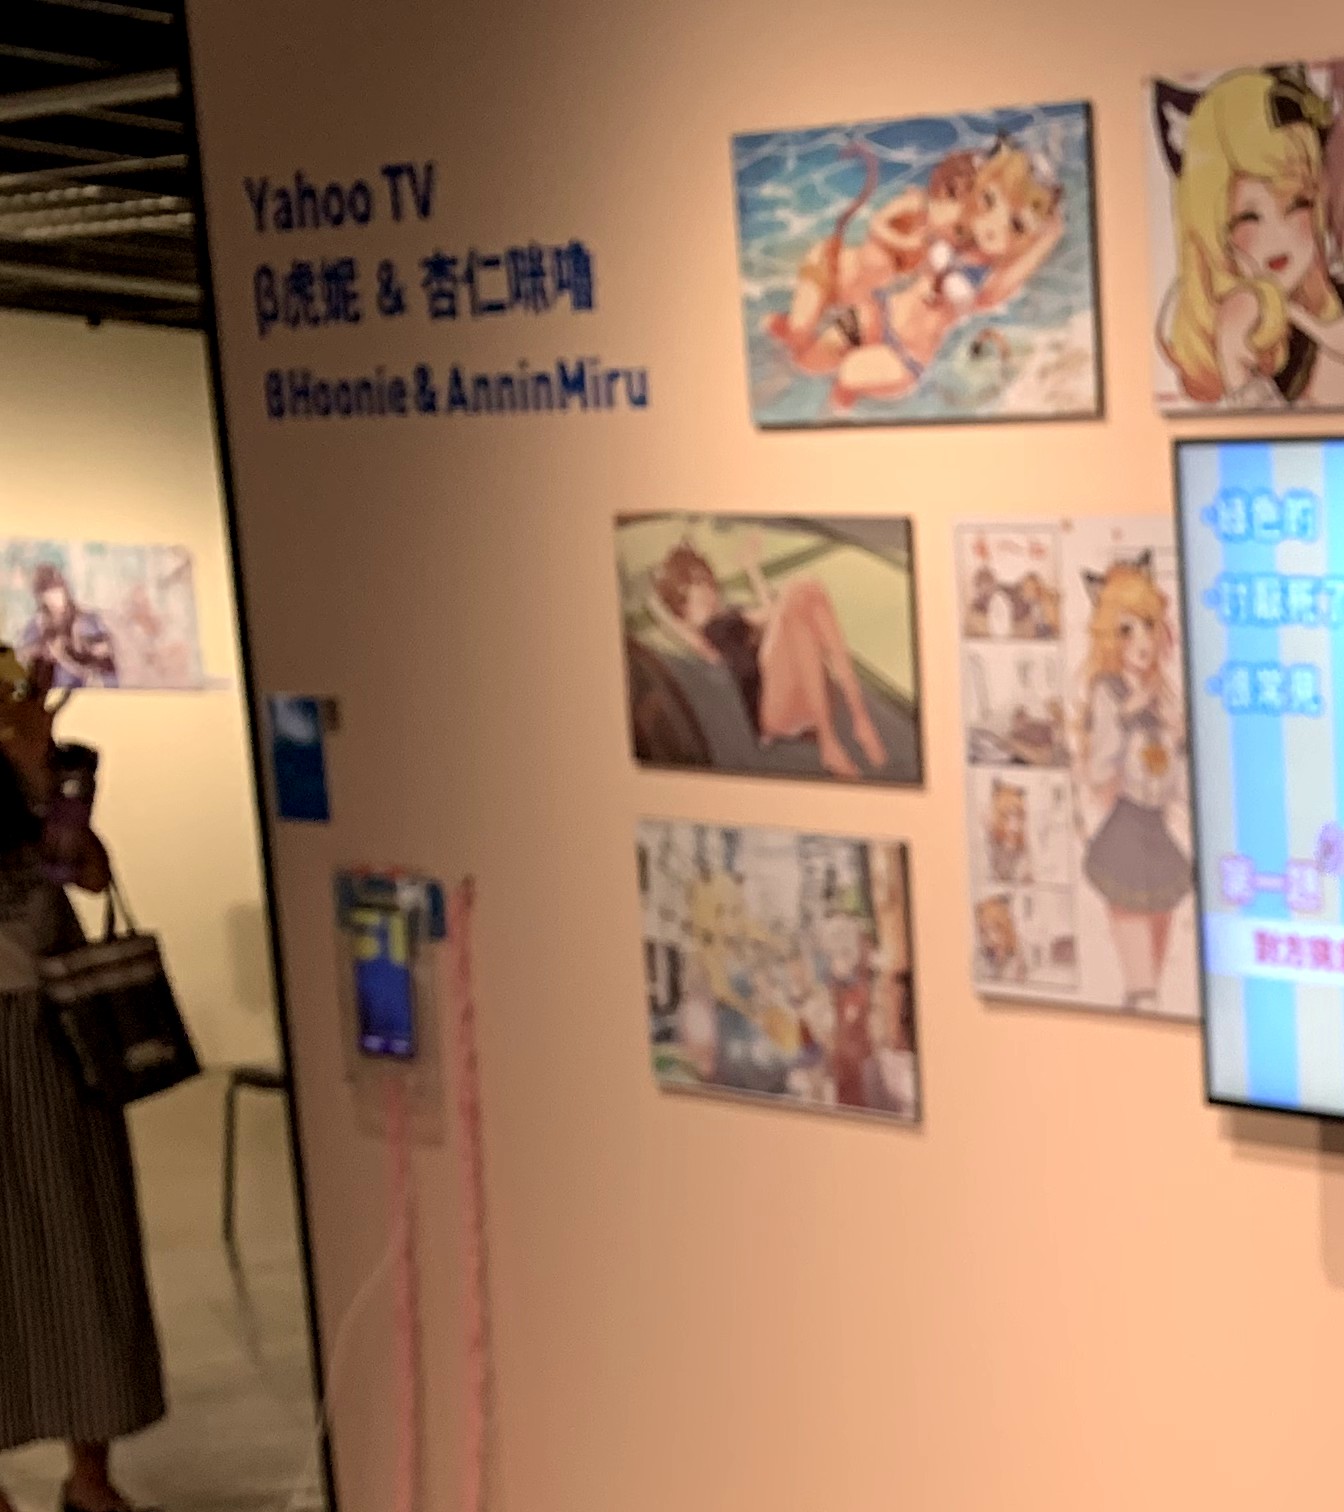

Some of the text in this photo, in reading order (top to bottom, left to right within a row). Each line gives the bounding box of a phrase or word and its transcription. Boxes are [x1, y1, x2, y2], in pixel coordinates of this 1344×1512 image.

[243, 160, 437, 232] Yahoo TV
[377, 258, 405, 317] &
